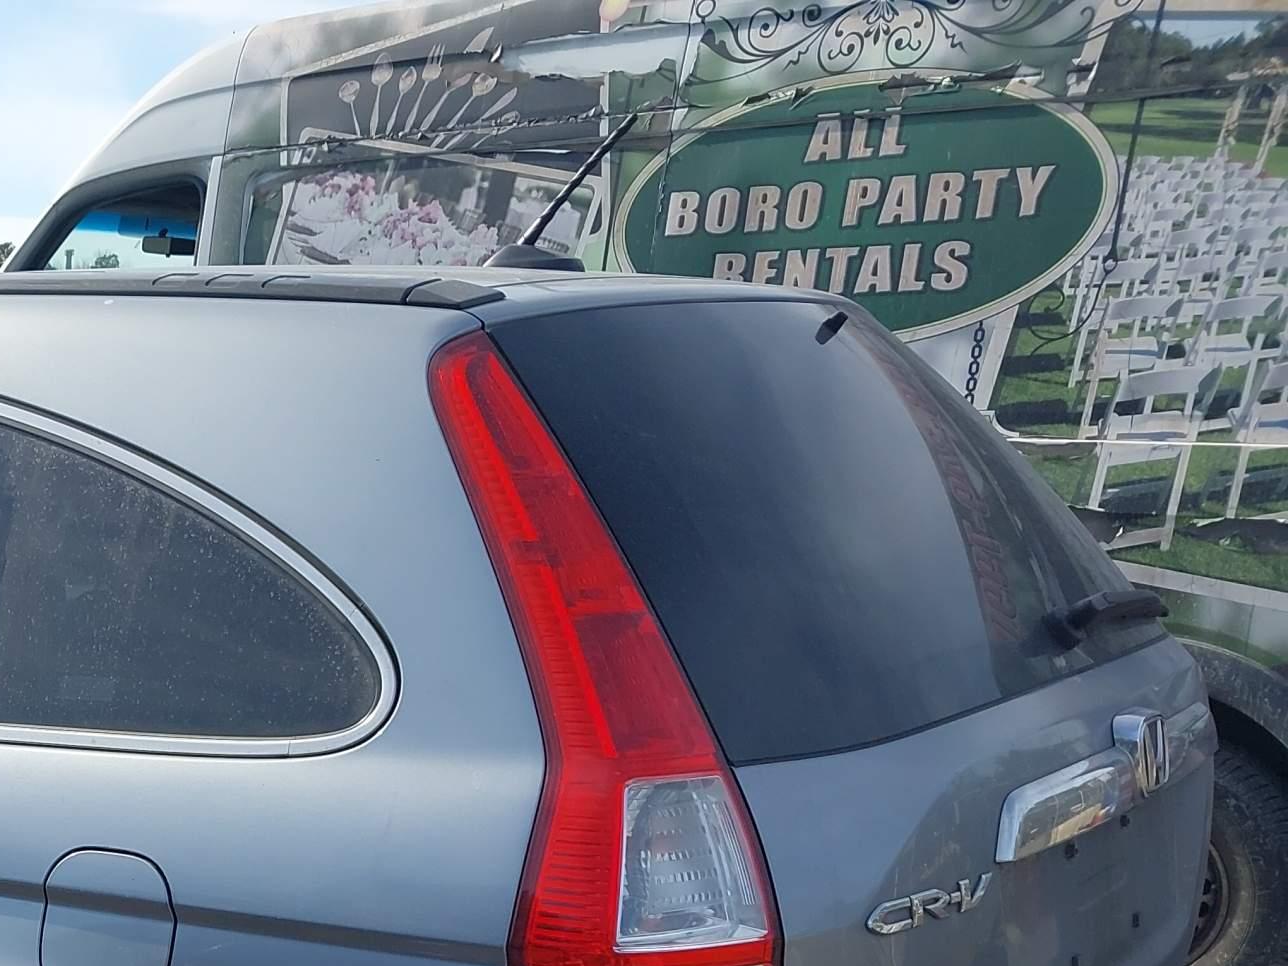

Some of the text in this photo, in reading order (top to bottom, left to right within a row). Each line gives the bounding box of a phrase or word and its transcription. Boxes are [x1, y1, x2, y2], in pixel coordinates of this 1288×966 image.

[804, 106, 907, 164] ALL
[664, 164, 1057, 237] BORO PARTY
[866, 871, 994, 935] CR-V
